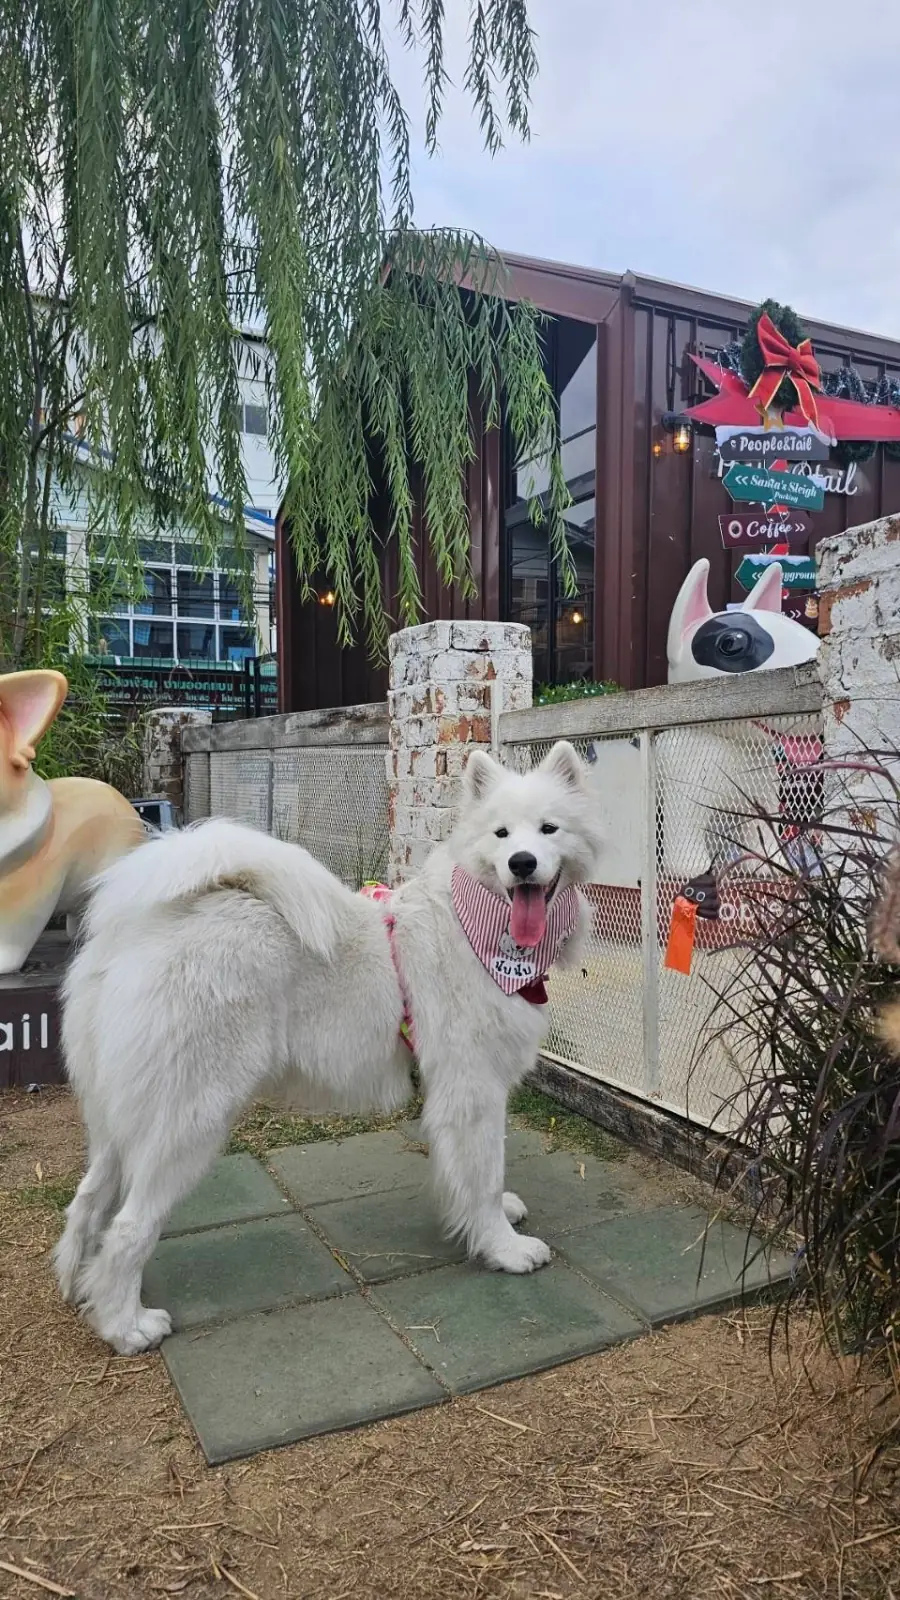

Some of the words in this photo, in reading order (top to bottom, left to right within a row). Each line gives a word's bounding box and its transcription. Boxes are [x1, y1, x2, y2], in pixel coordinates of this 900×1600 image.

[740, 436, 812, 454] People&Tail
[750, 474, 787, 490] Santa's
[788, 481, 817, 498] Sleigh
[746, 520, 793, 538] Coffee
[783, 571, 816, 582] ygroun
